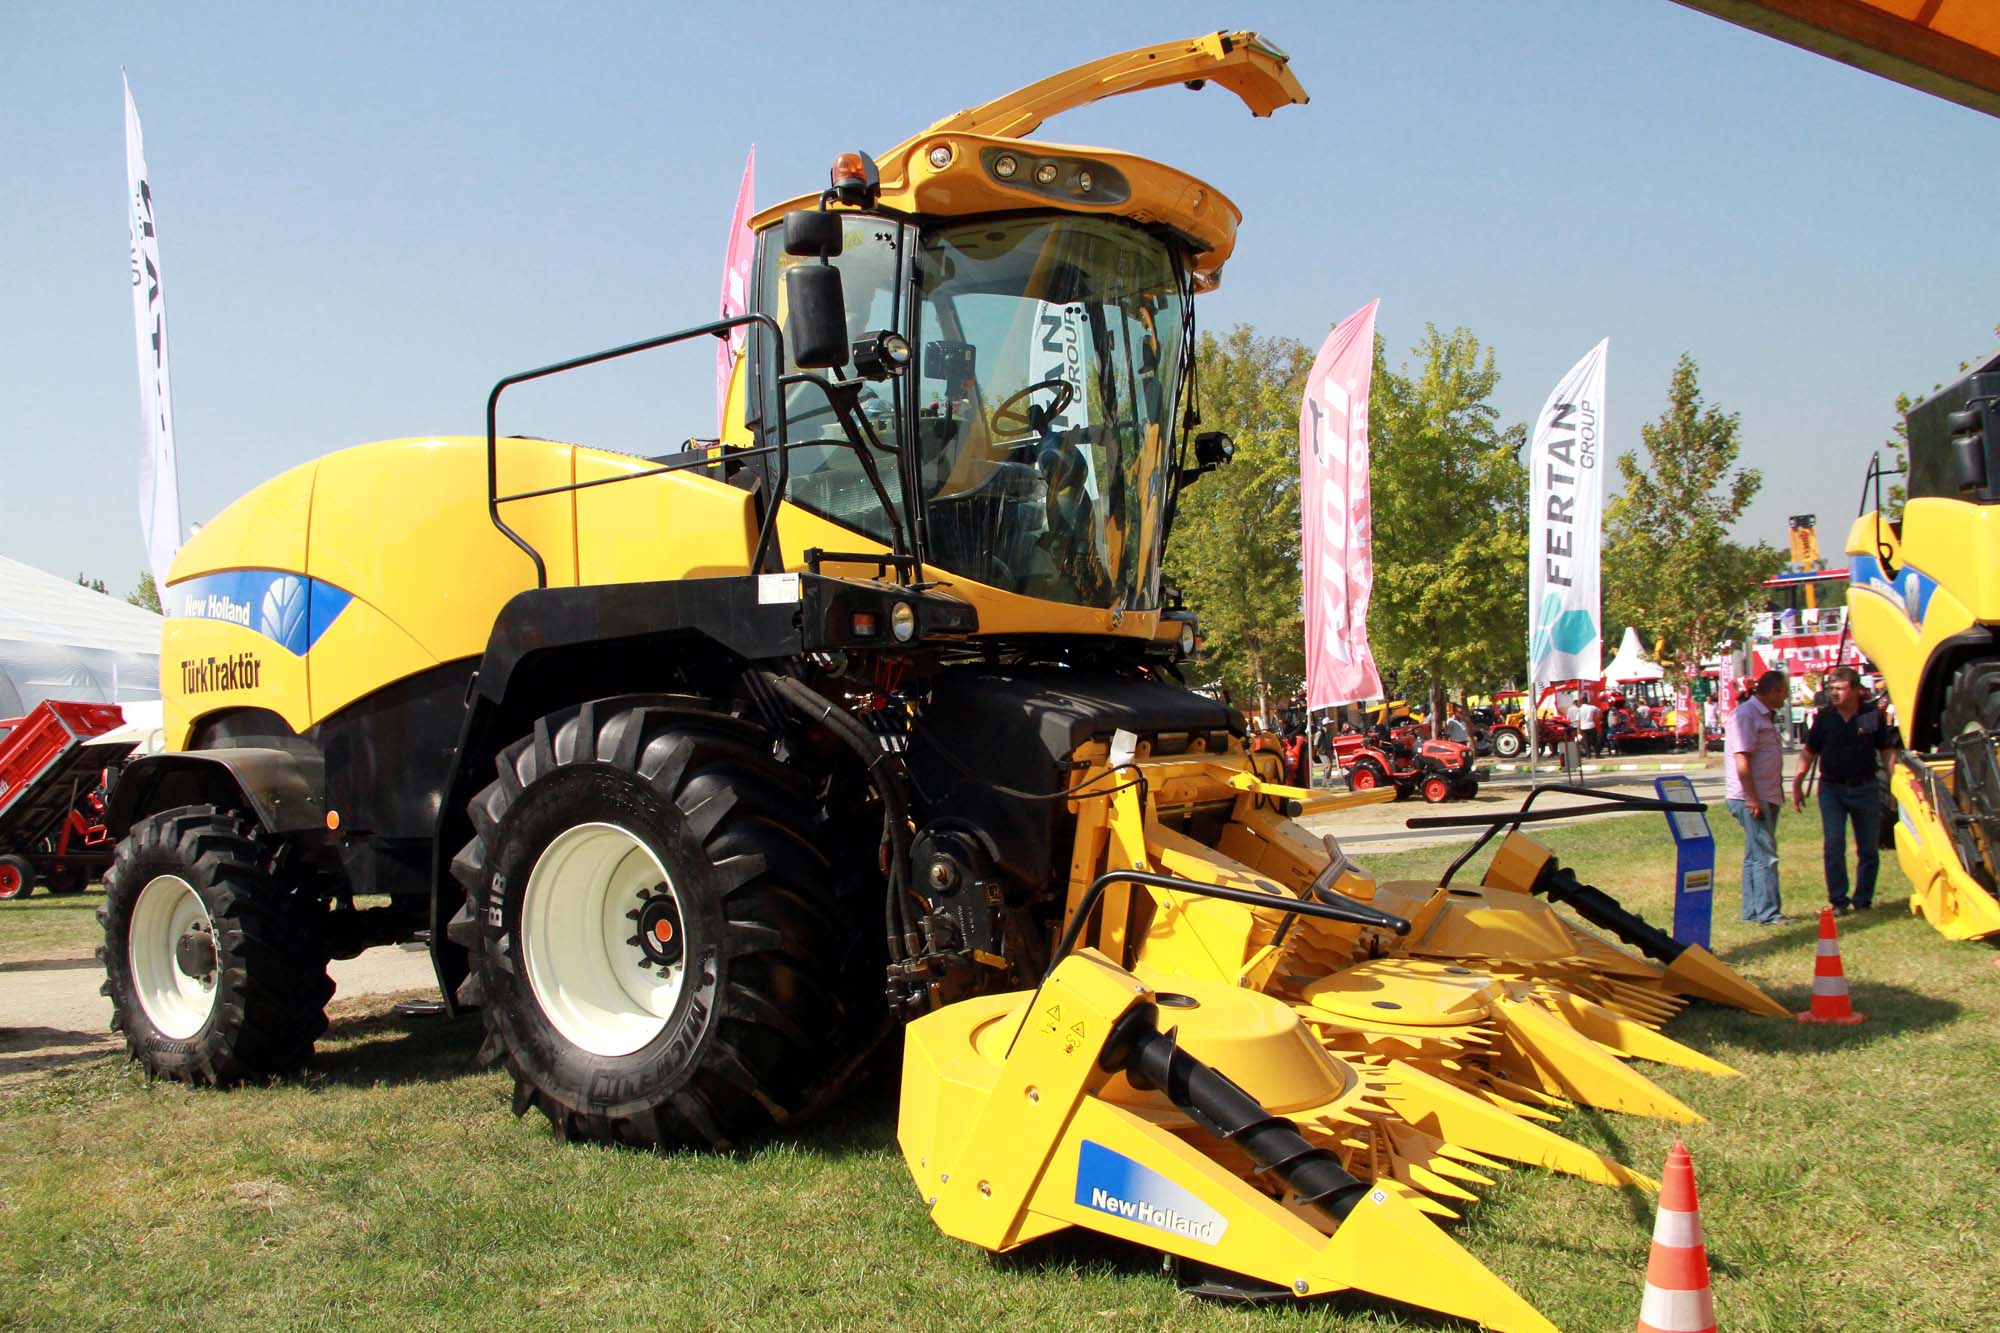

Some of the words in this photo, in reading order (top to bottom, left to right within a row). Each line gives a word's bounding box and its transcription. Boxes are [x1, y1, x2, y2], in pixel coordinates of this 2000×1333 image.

[1580, 400, 1595, 470] GROUP
[1323, 376, 1350, 664] KIOTI
[1546, 402, 1577, 587] FERTAN
[185, 594, 207, 617] New
[208, 594, 250, 626] Holland
[181, 652, 260, 694] TürkTraktör
[1091, 1187, 1137, 1217] New
[1137, 1200, 1216, 1238] Holland
